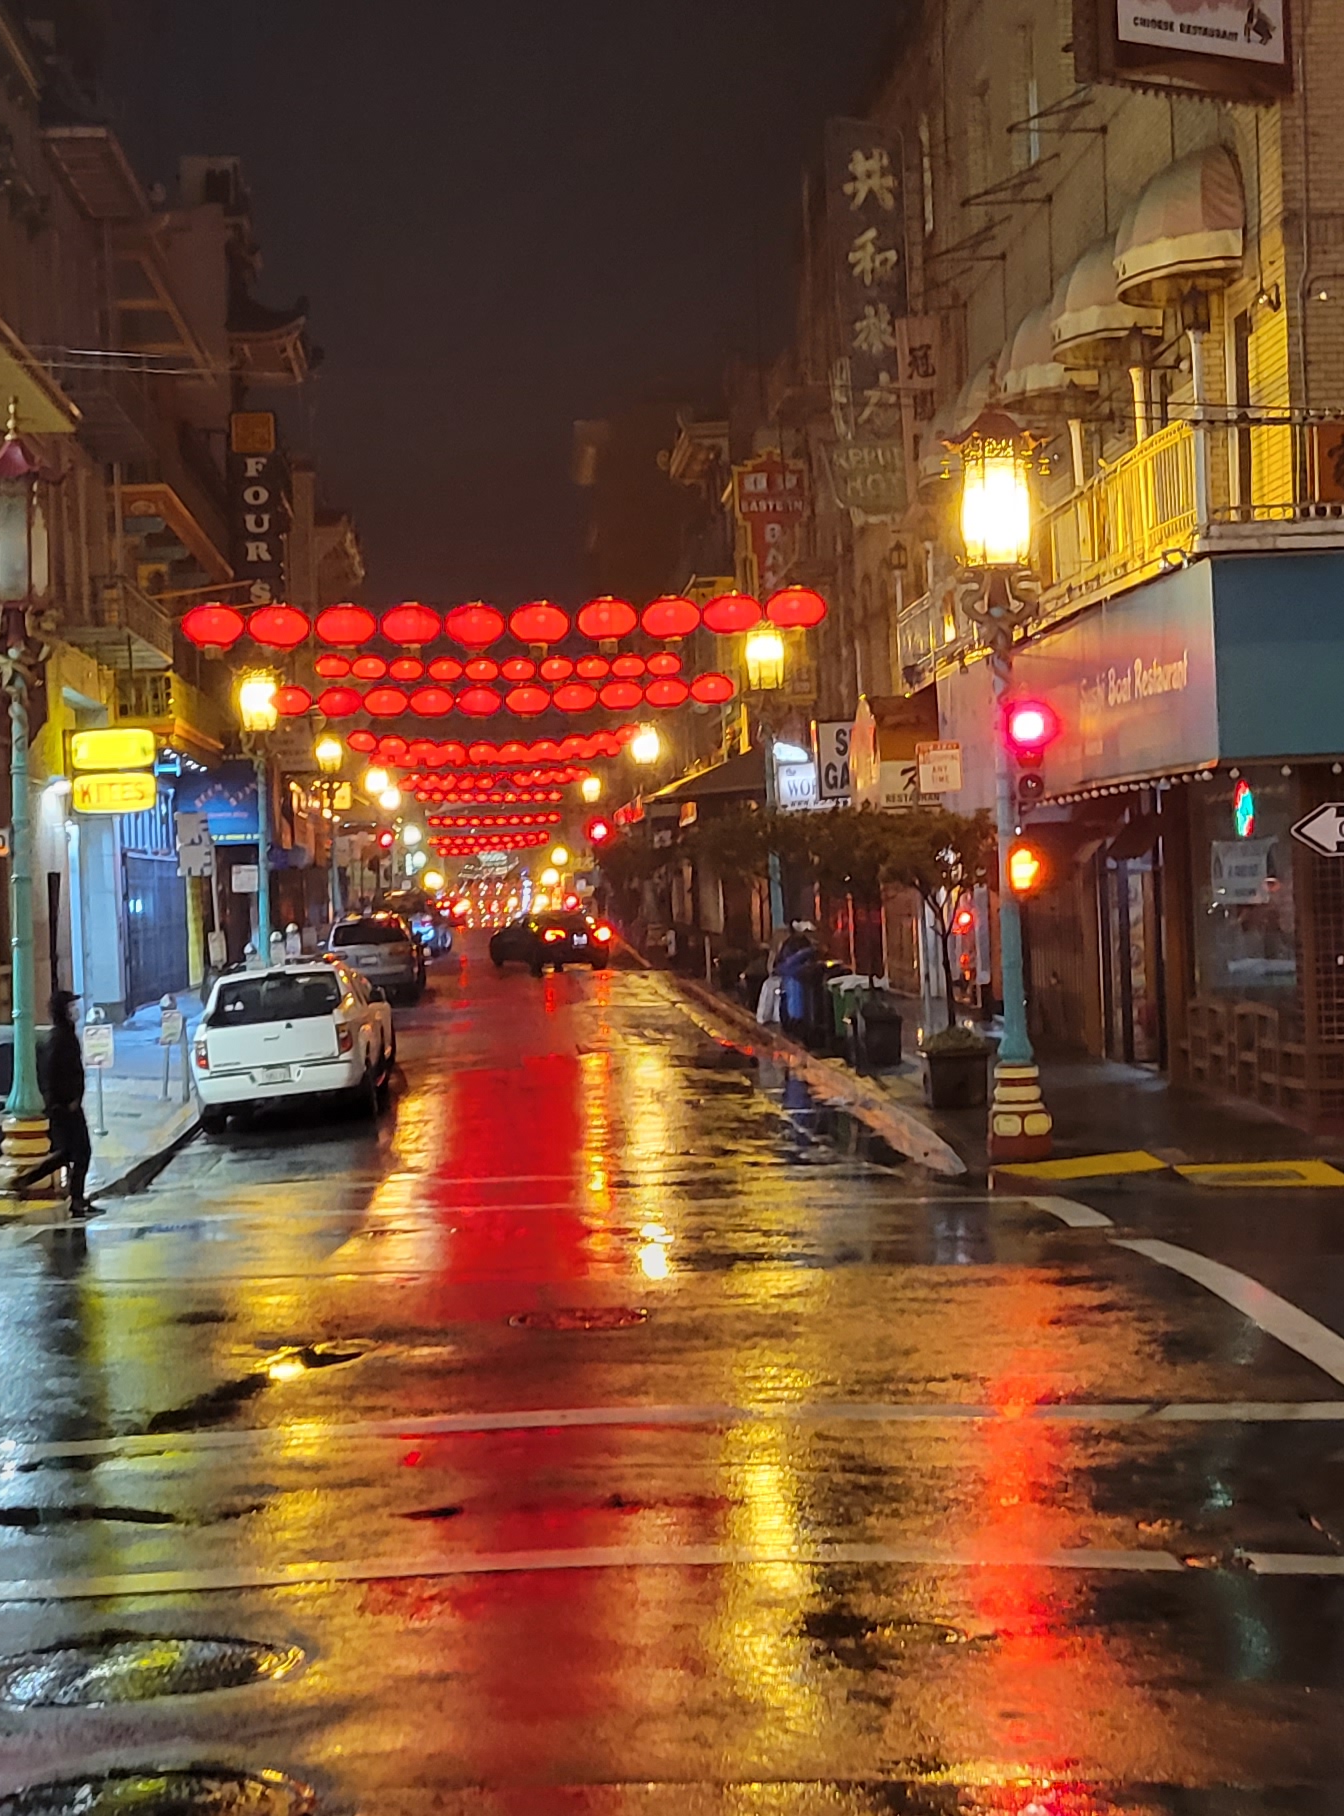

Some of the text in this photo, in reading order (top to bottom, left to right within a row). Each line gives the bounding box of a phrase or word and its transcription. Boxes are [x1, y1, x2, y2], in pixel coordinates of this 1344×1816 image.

[1179, 22, 1239, 42] RESTAURANT
[242, 457, 272, 562] FOUR
[1107, 666, 1132, 708] Boat
